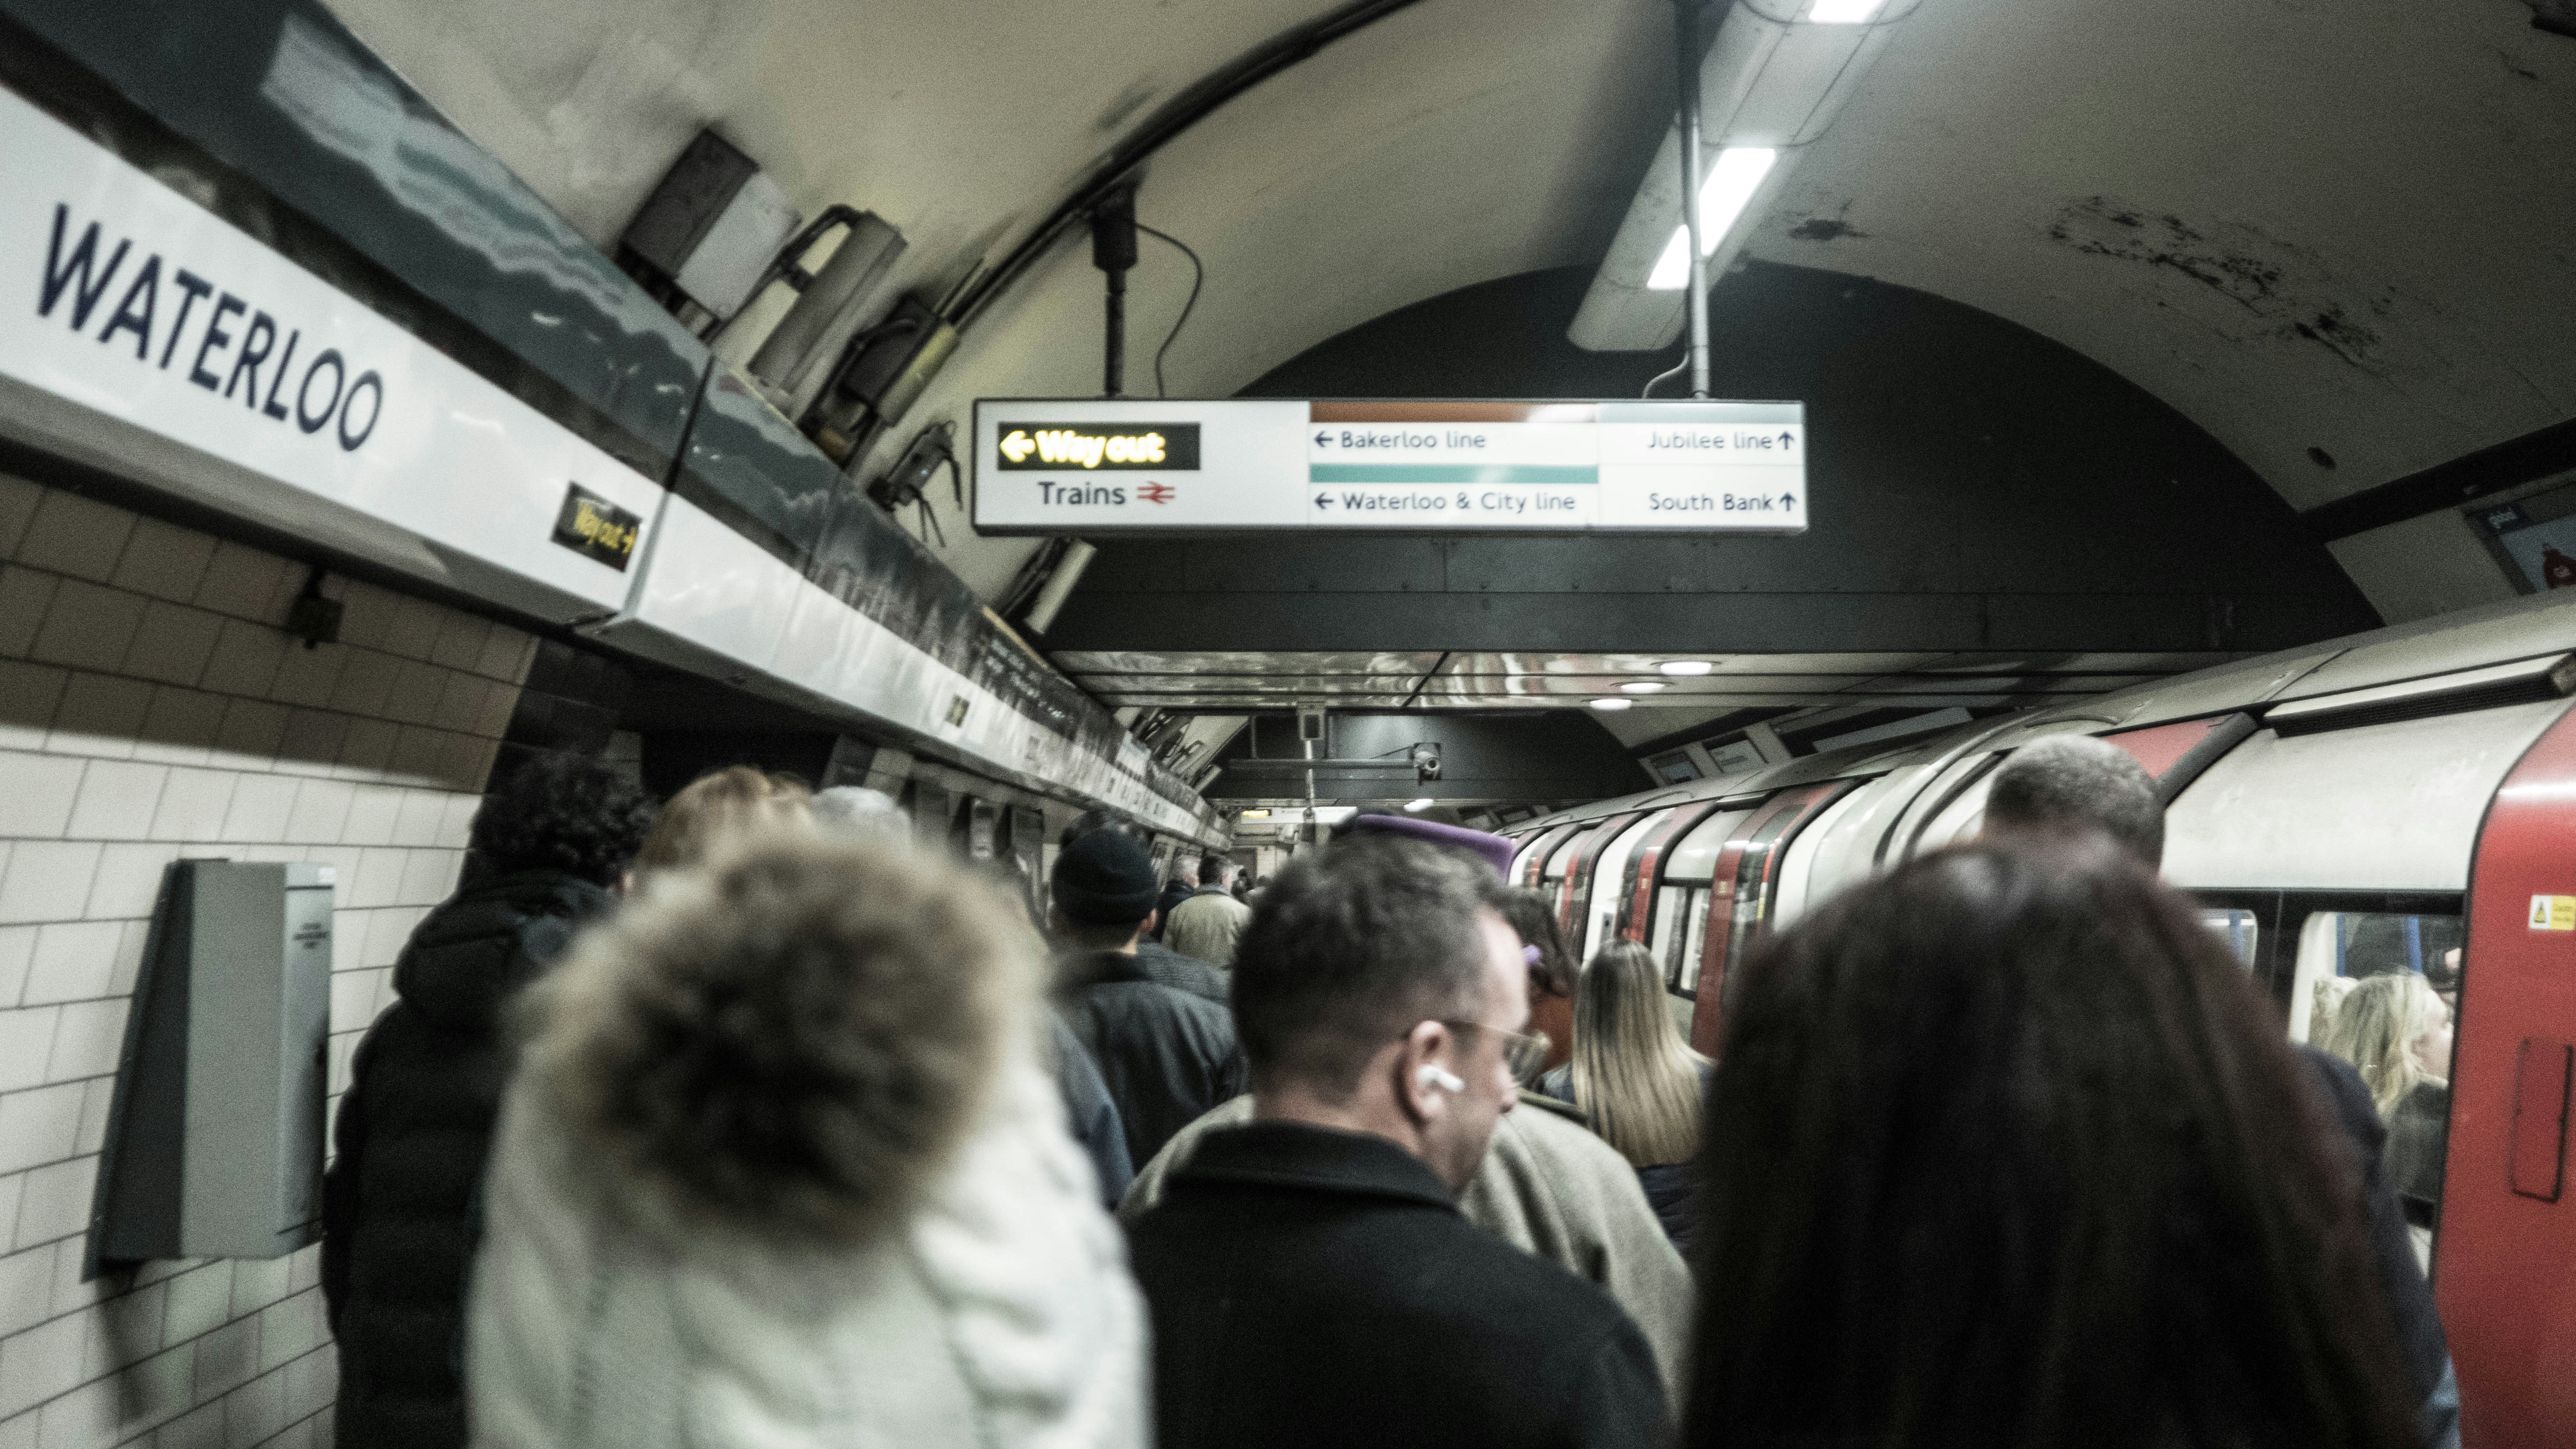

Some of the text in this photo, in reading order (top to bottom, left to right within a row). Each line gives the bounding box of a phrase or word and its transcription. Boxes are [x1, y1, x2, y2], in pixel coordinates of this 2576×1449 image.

[37, 203, 384, 451] WATERLOO
[1035, 430, 1166, 469] Way out
[1341, 431, 1487, 448] Bakerloo line
[1648, 431, 1773, 449] Jubilee line
[1038, 481, 1126, 505] Trains
[1342, 492, 1575, 514] Waterloo & City line
[1649, 492, 1773, 511] South Bank
